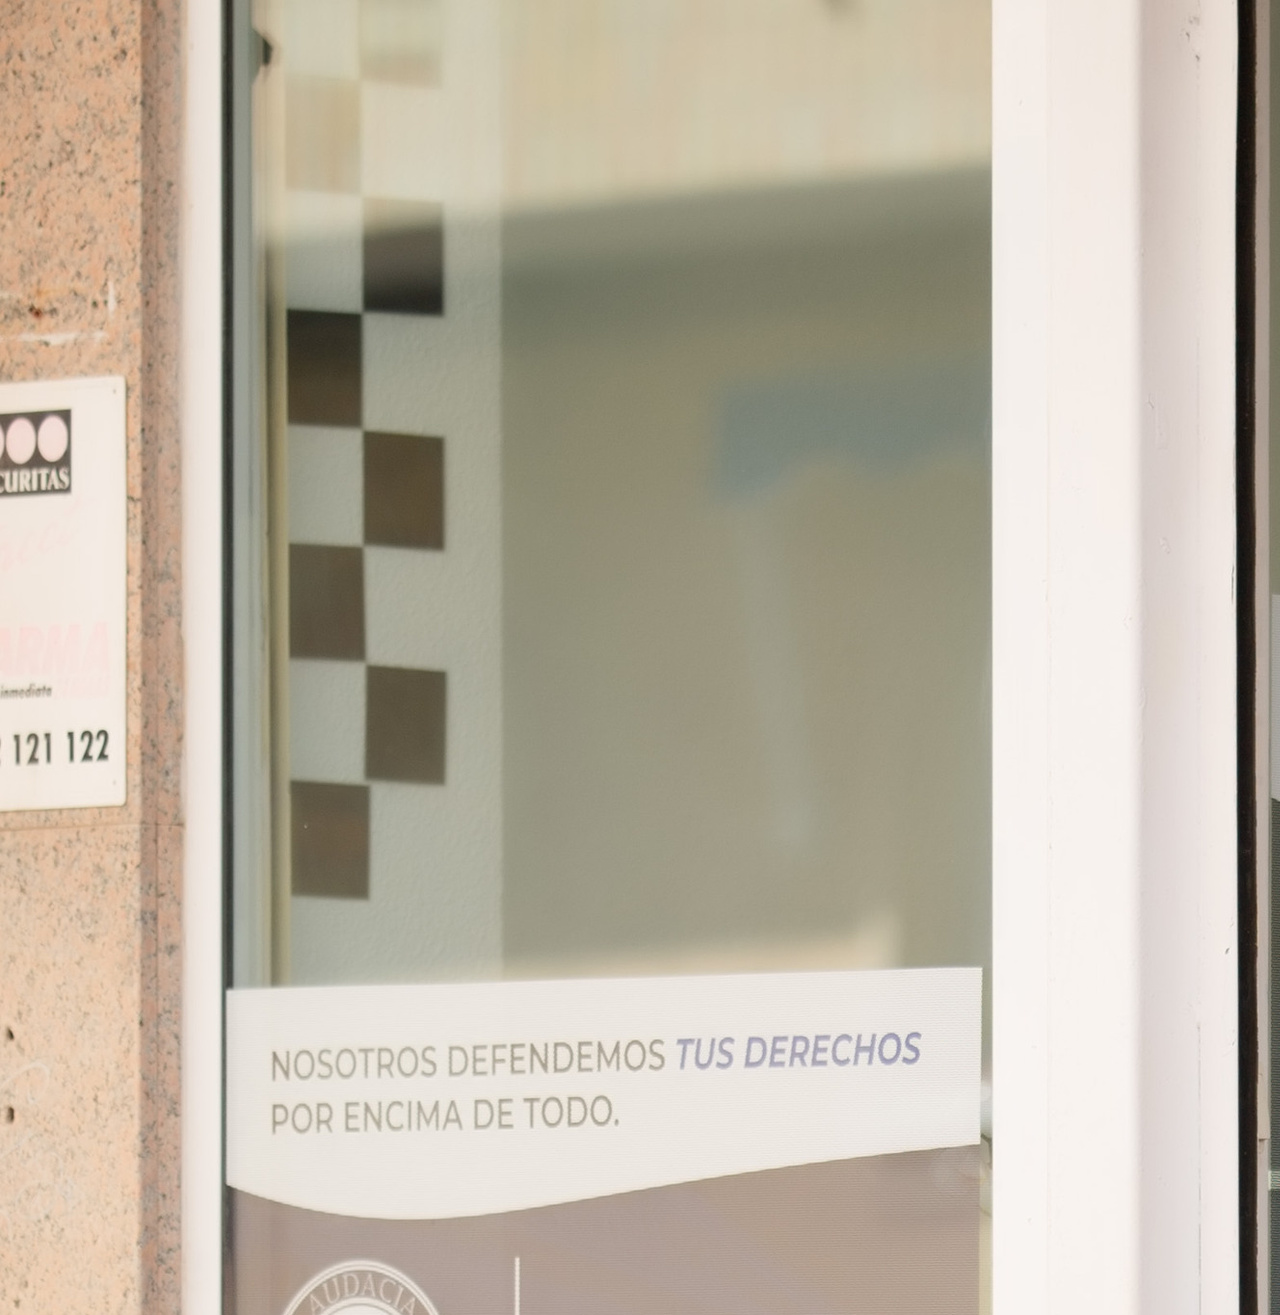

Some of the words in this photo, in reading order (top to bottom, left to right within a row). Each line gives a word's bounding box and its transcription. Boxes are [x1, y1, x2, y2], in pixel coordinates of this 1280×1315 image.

[13, 732, 52, 765] 121
[66, 728, 110, 763] 122
[271, 1045, 438, 1082] NOSOTROS
[448, 1038, 666, 1077] DEFENDEMOS
[676, 1036, 735, 1071] TUS
[743, 1031, 922, 1069] DERECHOS
[271, 1102, 334, 1135] POR
[344, 1099, 463, 1133] ENCIMA
[473, 1097, 514, 1130] DE
[522, 1094, 620, 1129] TODO.
